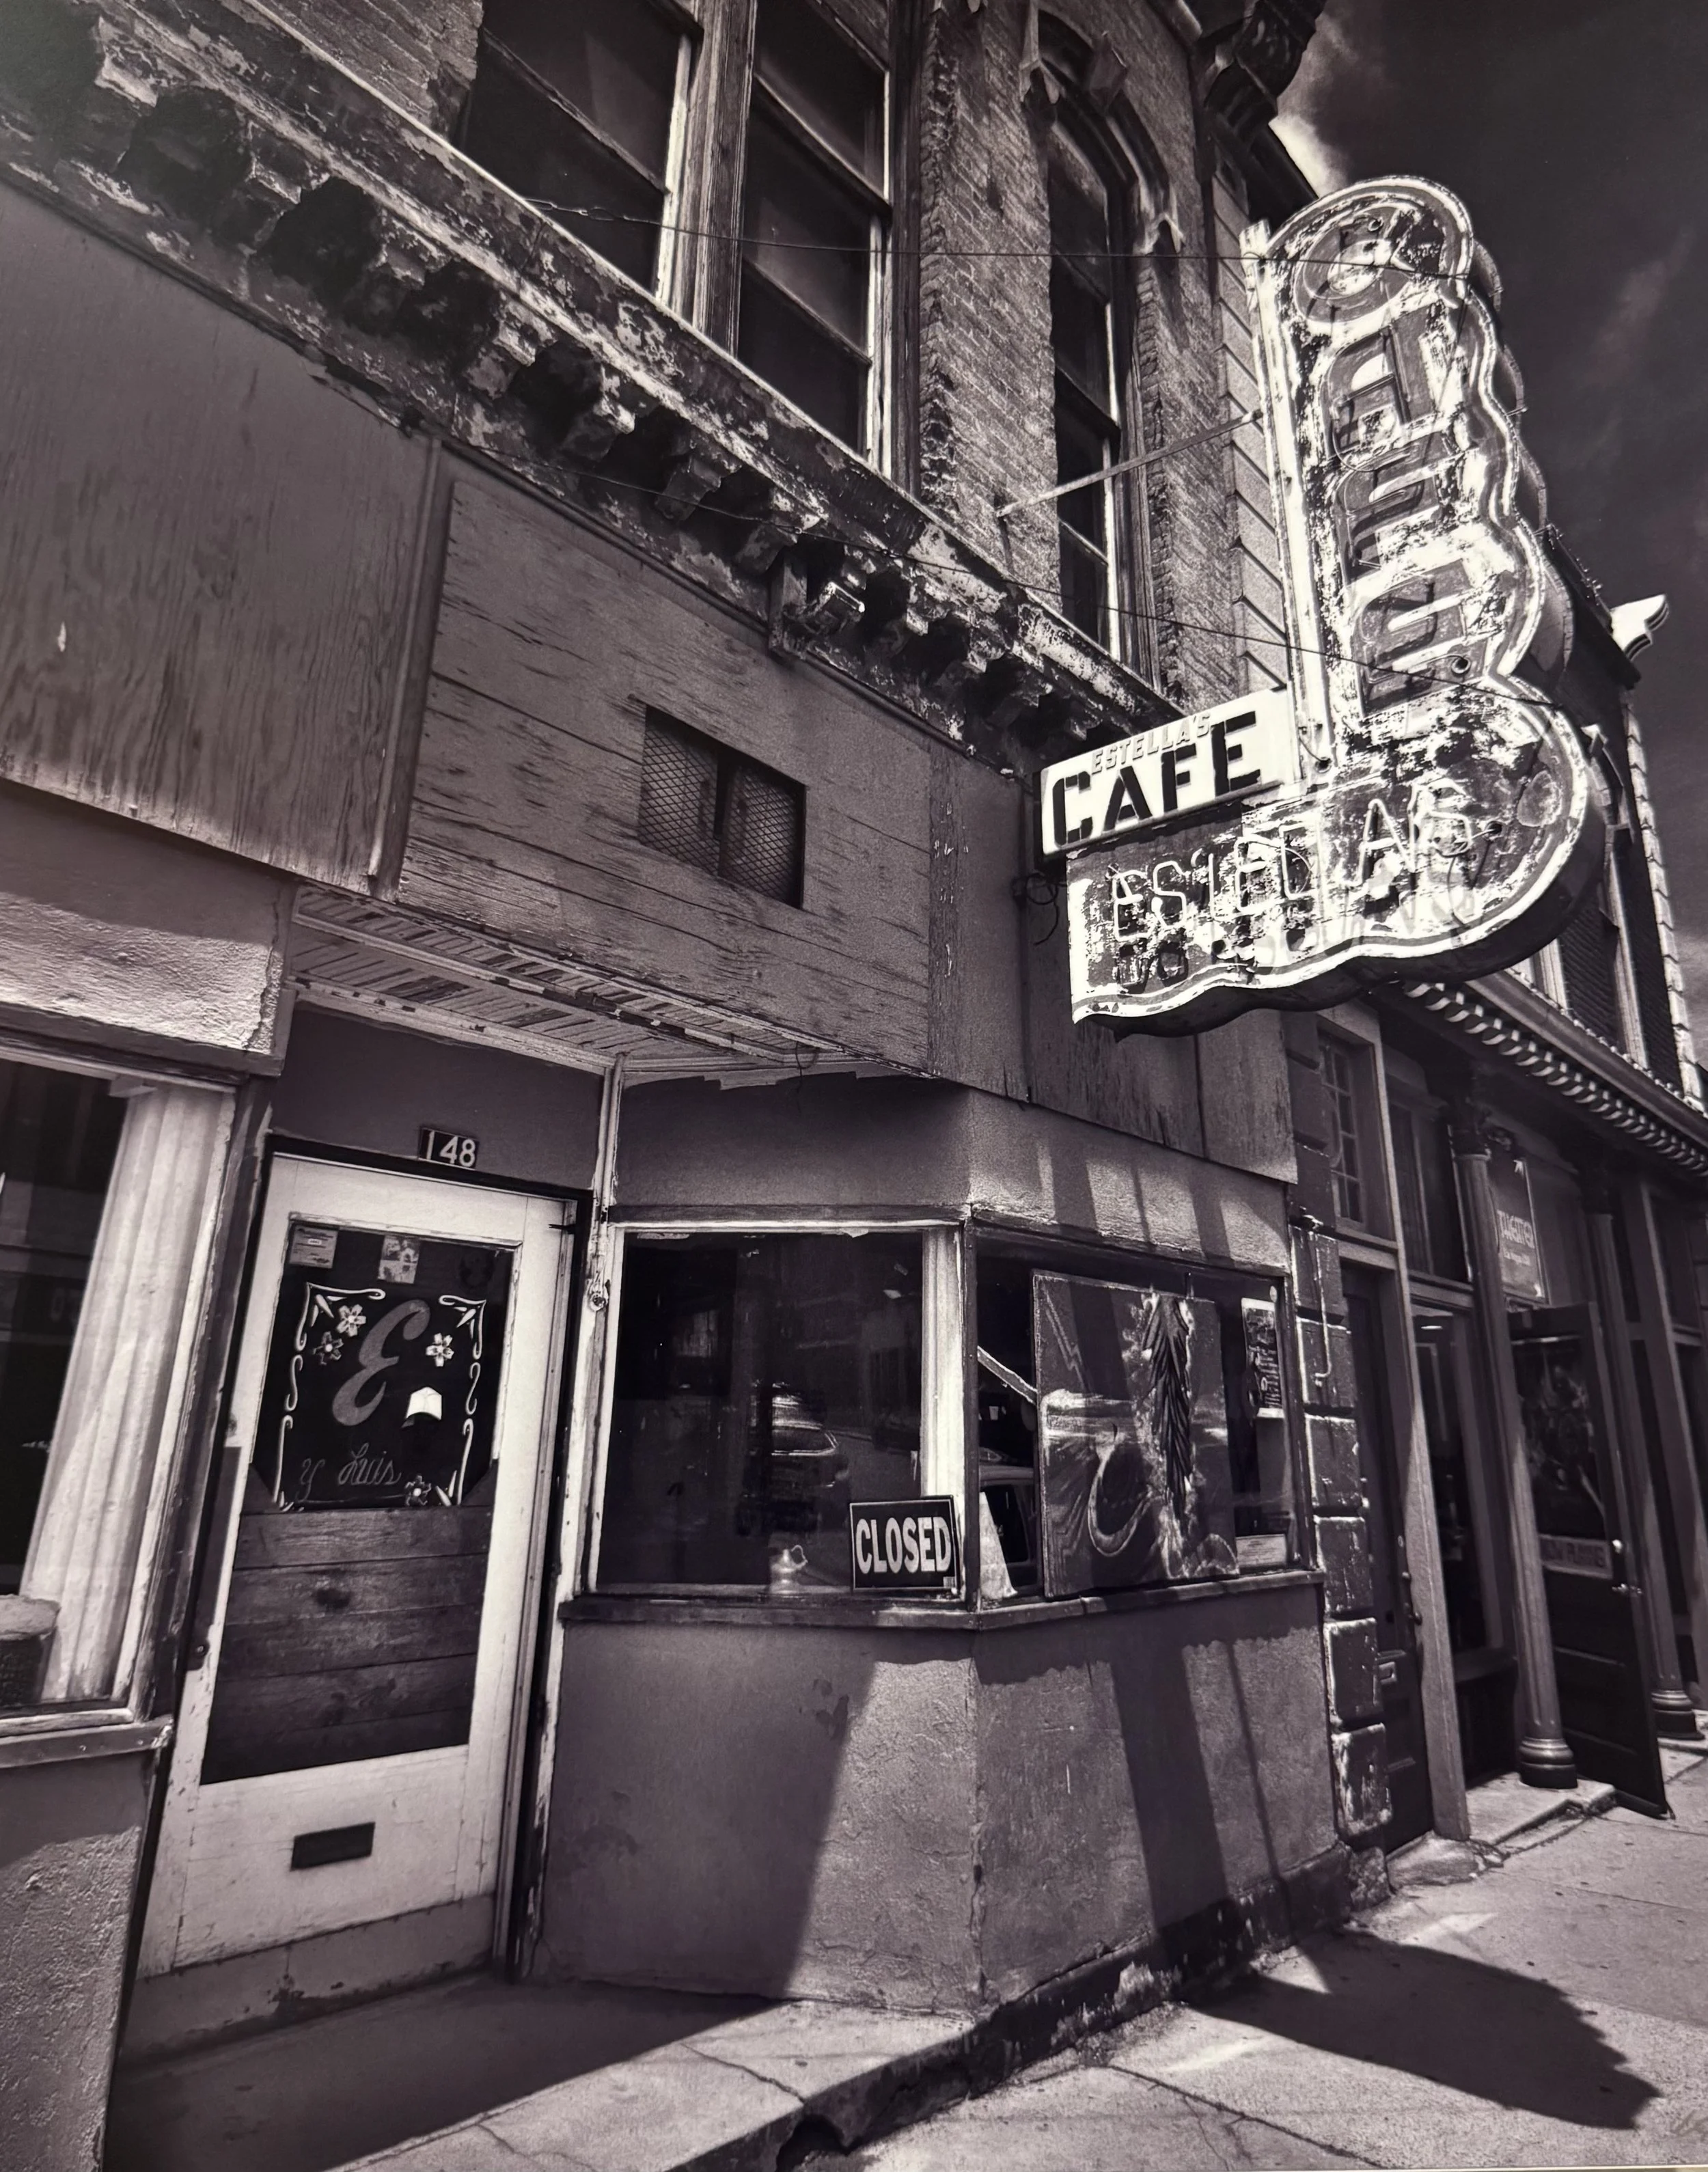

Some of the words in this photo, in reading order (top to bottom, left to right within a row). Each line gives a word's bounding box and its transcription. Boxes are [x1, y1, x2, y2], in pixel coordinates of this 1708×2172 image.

[1091, 711, 1211, 775] ESTELLA'S
[1053, 711, 1261, 846] CAFE
[426, 1130, 476, 1168] 148
[332, 1300, 430, 1426] E
[338, 1442, 401, 1485] Luis
[855, 1517, 952, 1574] CLOSED
